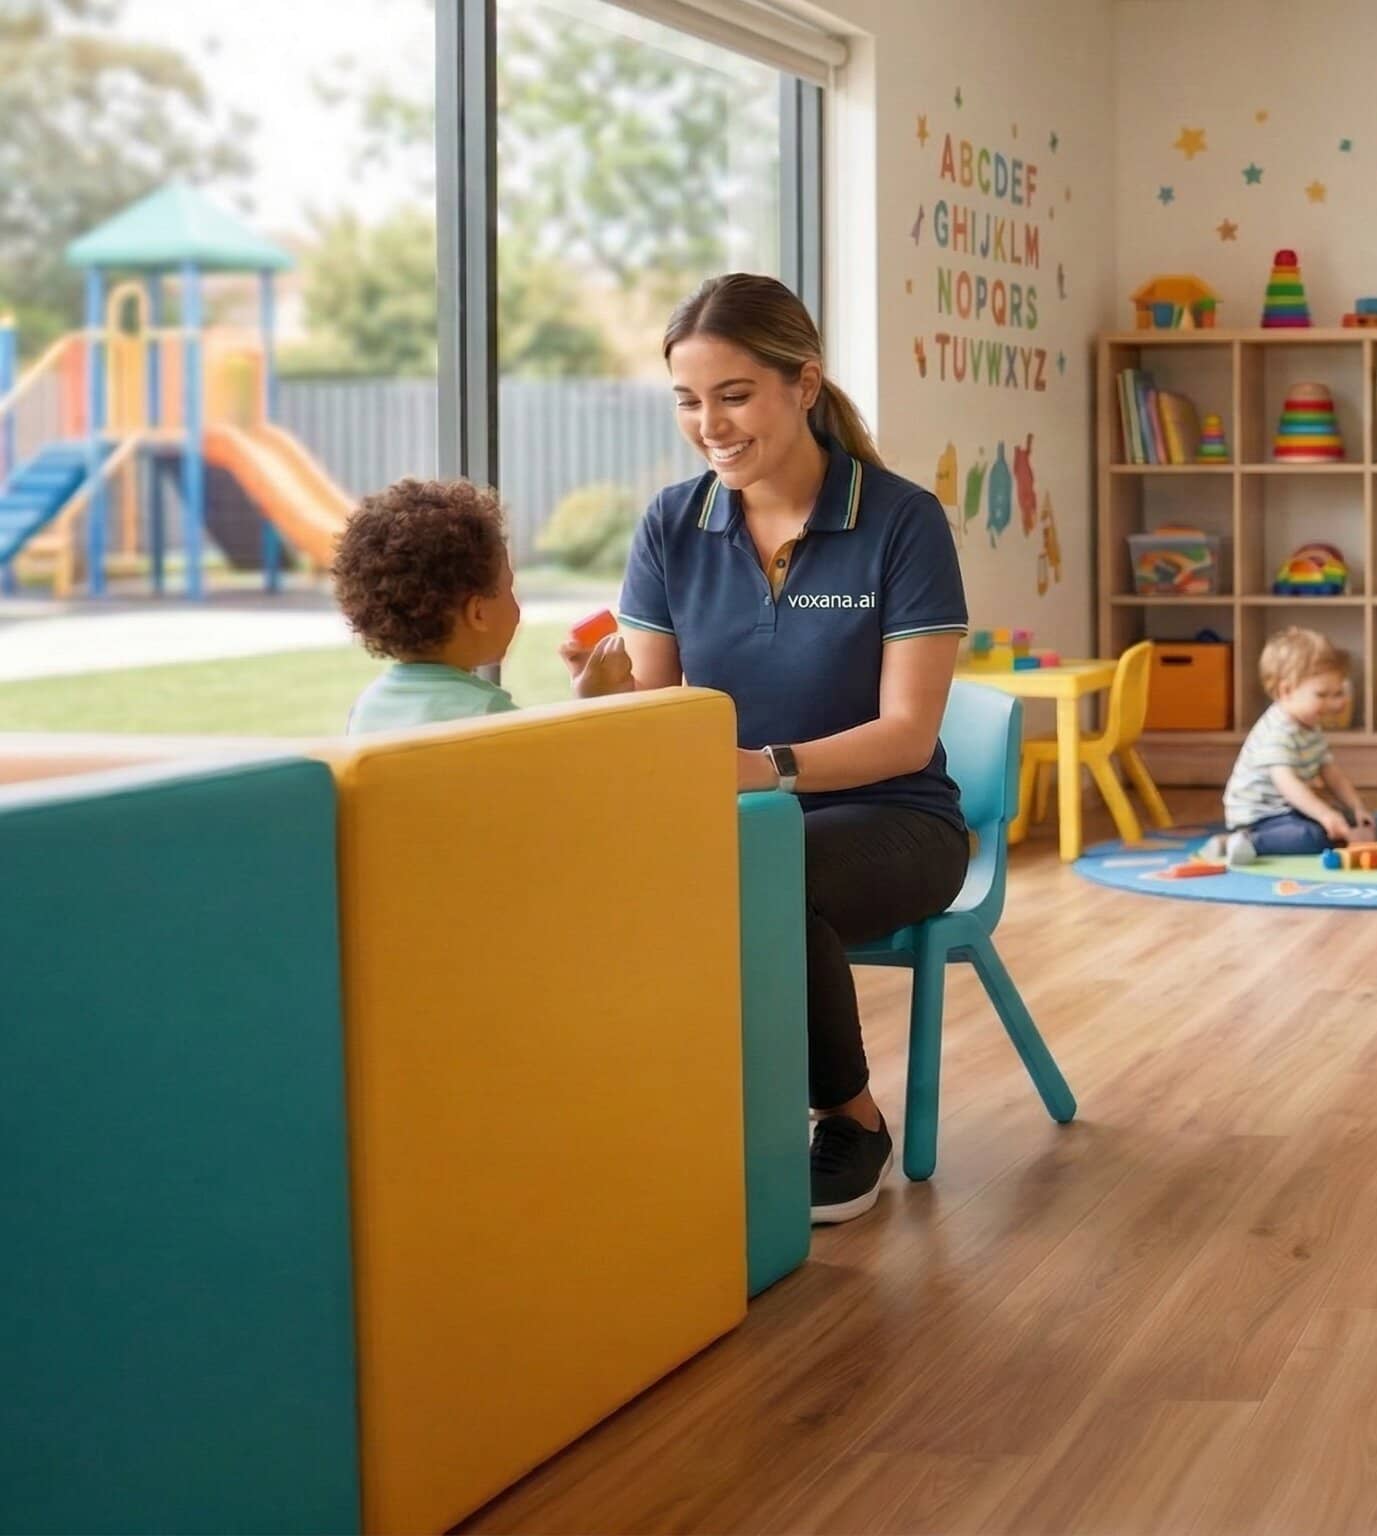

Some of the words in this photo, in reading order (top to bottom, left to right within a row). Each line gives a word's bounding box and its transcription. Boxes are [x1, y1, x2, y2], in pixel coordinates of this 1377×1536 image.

[940, 133, 1038, 208] ABCDEF
[934, 200, 1040, 269] GHIJKLM
[937, 267, 1039, 331] NOPQRS
[935, 333, 1047, 392] TUVWXYZ
[787, 591, 876, 609] voxana.ai
